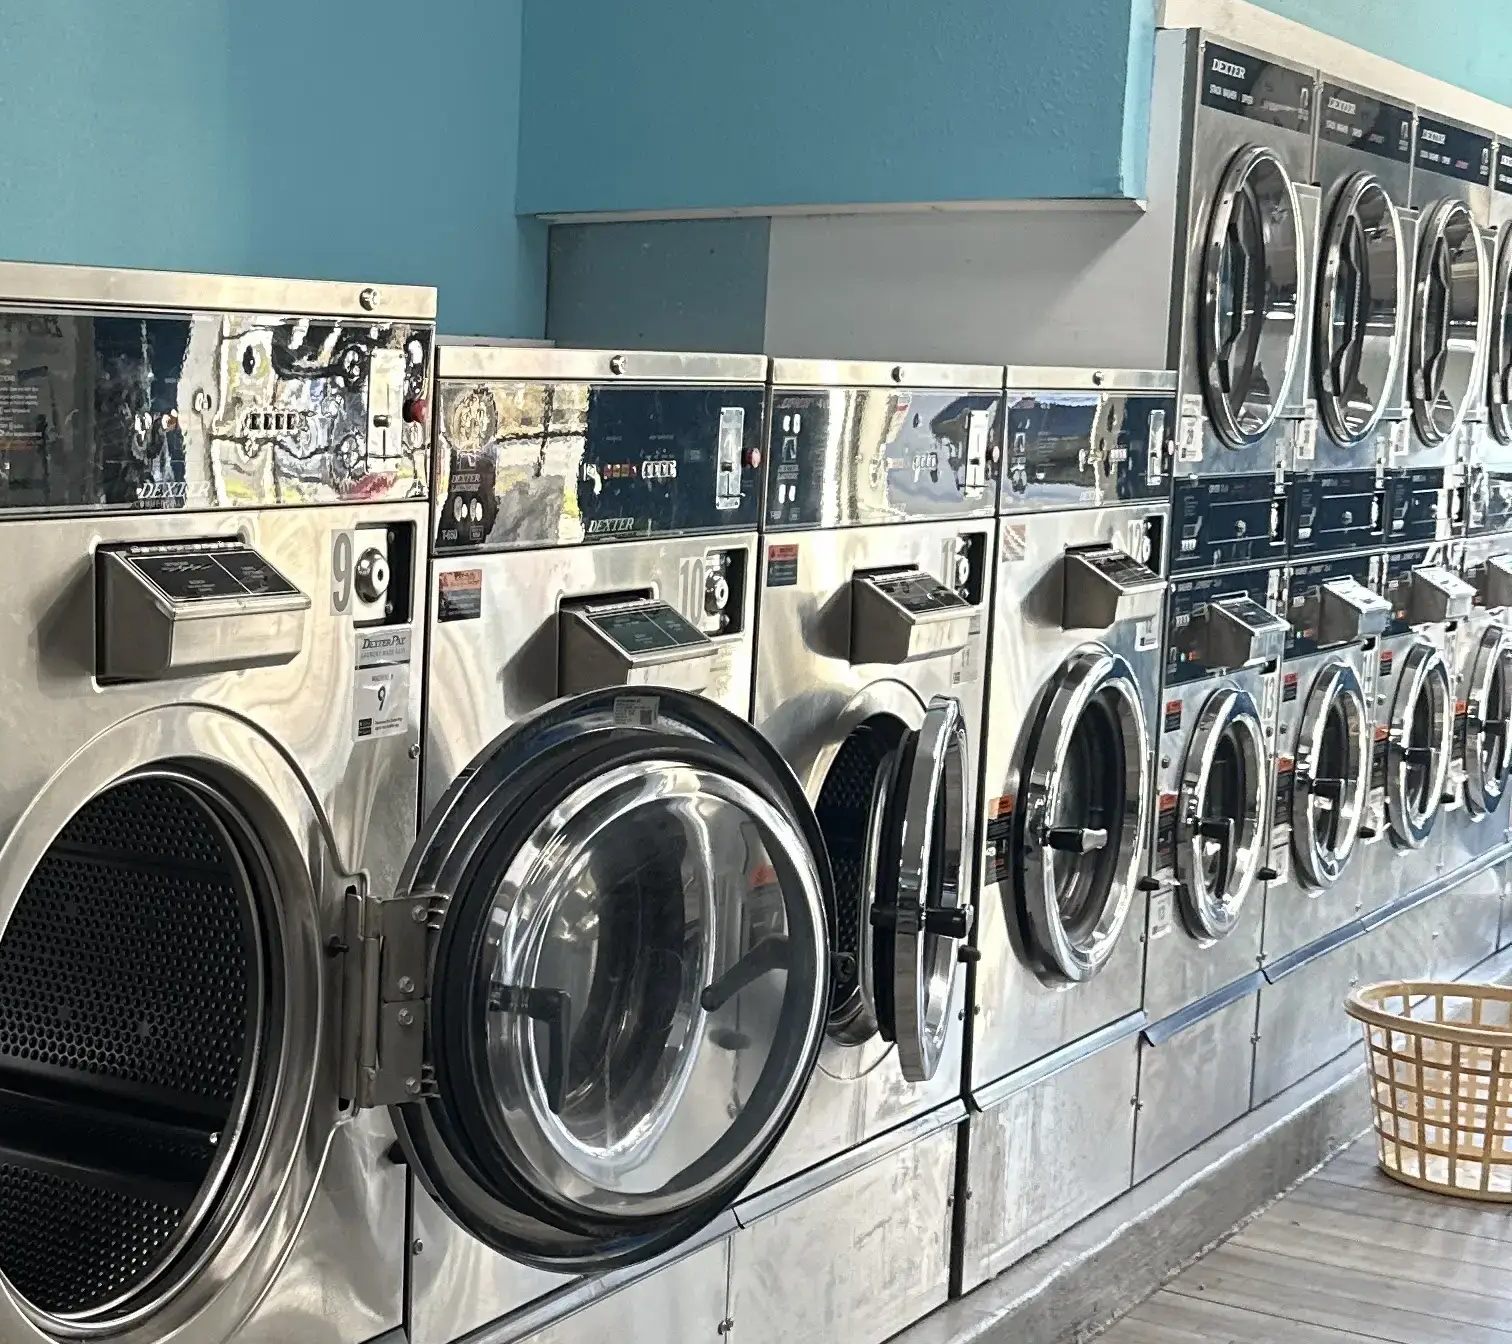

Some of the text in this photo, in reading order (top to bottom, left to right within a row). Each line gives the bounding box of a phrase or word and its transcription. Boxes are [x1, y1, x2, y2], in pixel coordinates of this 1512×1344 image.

[1212, 58, 1246, 80] DEXTER
[588, 517, 634, 532] DEXTER
[333, 532, 352, 612] 9
[680, 558, 704, 625] 10
[378, 686, 386, 711] 9
